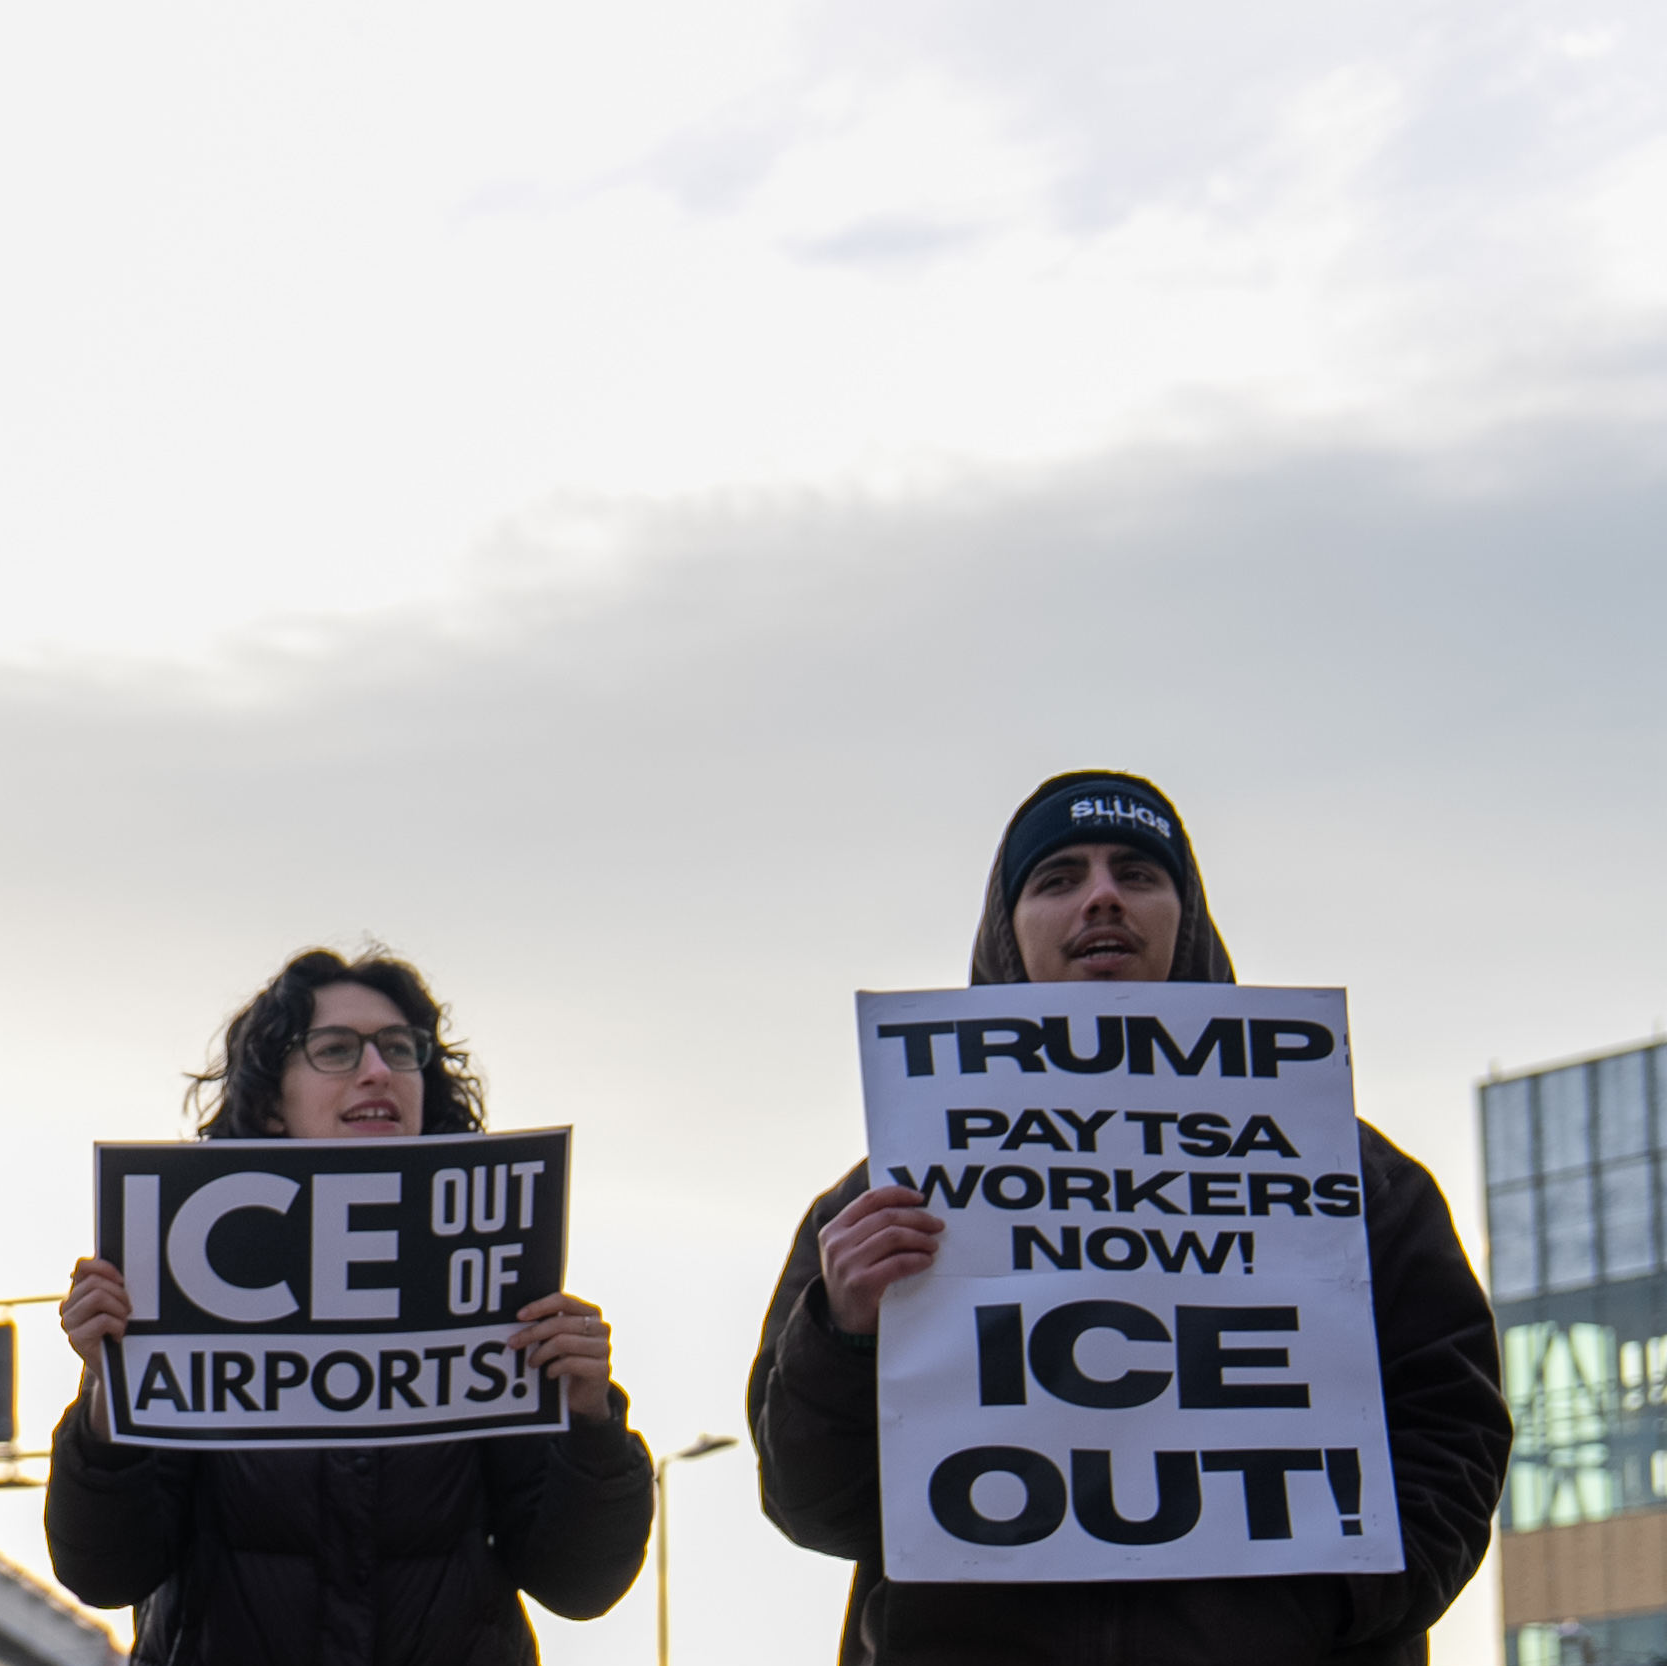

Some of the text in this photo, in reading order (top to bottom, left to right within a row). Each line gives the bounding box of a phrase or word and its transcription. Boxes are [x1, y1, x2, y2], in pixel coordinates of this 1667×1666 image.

[877, 1015, 1335, 1078] TRUMP
[946, 1108, 1301, 1159] PAY TSA
[431, 1160, 545, 1237] OUT
[886, 1165, 1361, 1218] WORKERS
[123, 1171, 402, 1323] ICE
[449, 1243, 522, 1316] OF
[1011, 1225, 1255, 1275] NOW!
[135, 1341, 529, 1413] AIRPORTS!
[974, 1300, 1311, 1411] ICE
[927, 1445, 1363, 1547] OUT!
